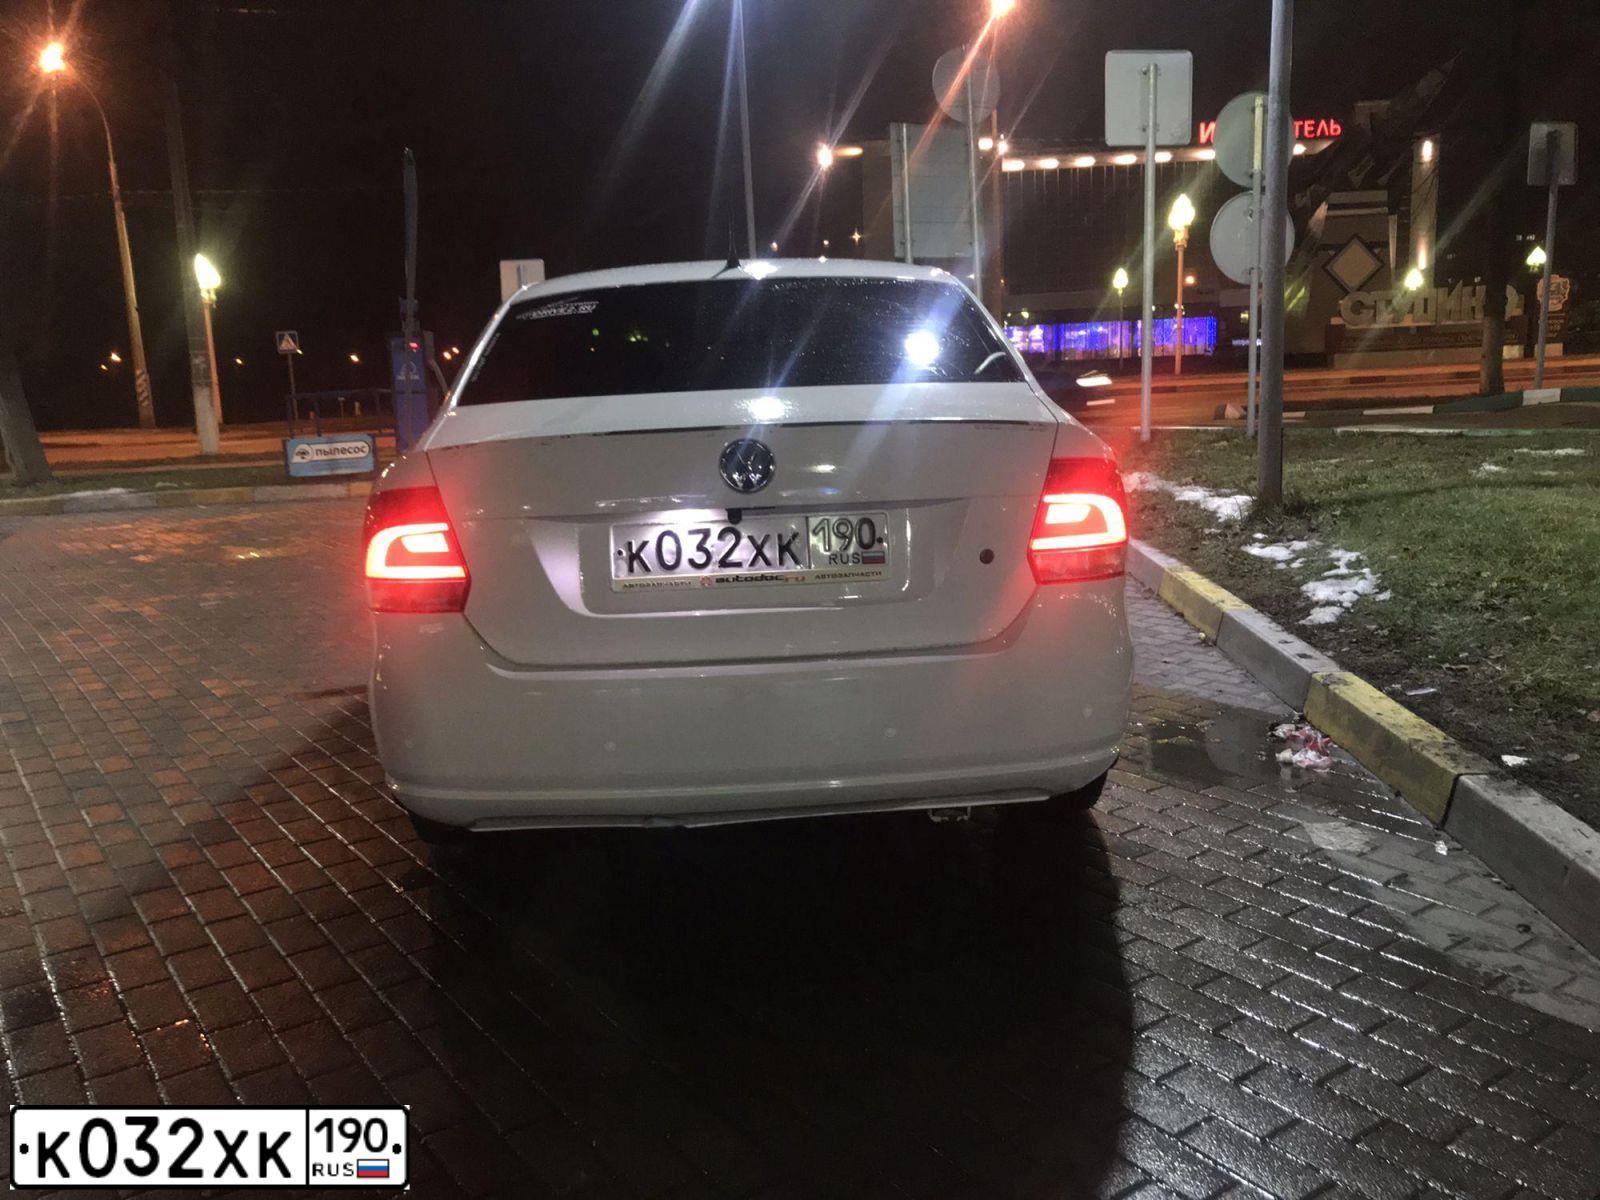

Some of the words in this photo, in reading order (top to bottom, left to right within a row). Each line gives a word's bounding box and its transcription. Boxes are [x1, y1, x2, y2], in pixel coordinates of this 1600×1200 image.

[315, 445, 367, 457] пылесос
[626, 526, 800, 573] К032ХК
[812, 517, 876, 552] 190
[828, 552, 861, 565] RUS
[815, 570, 883, 580] АВТОЗАПЧАСТИ
